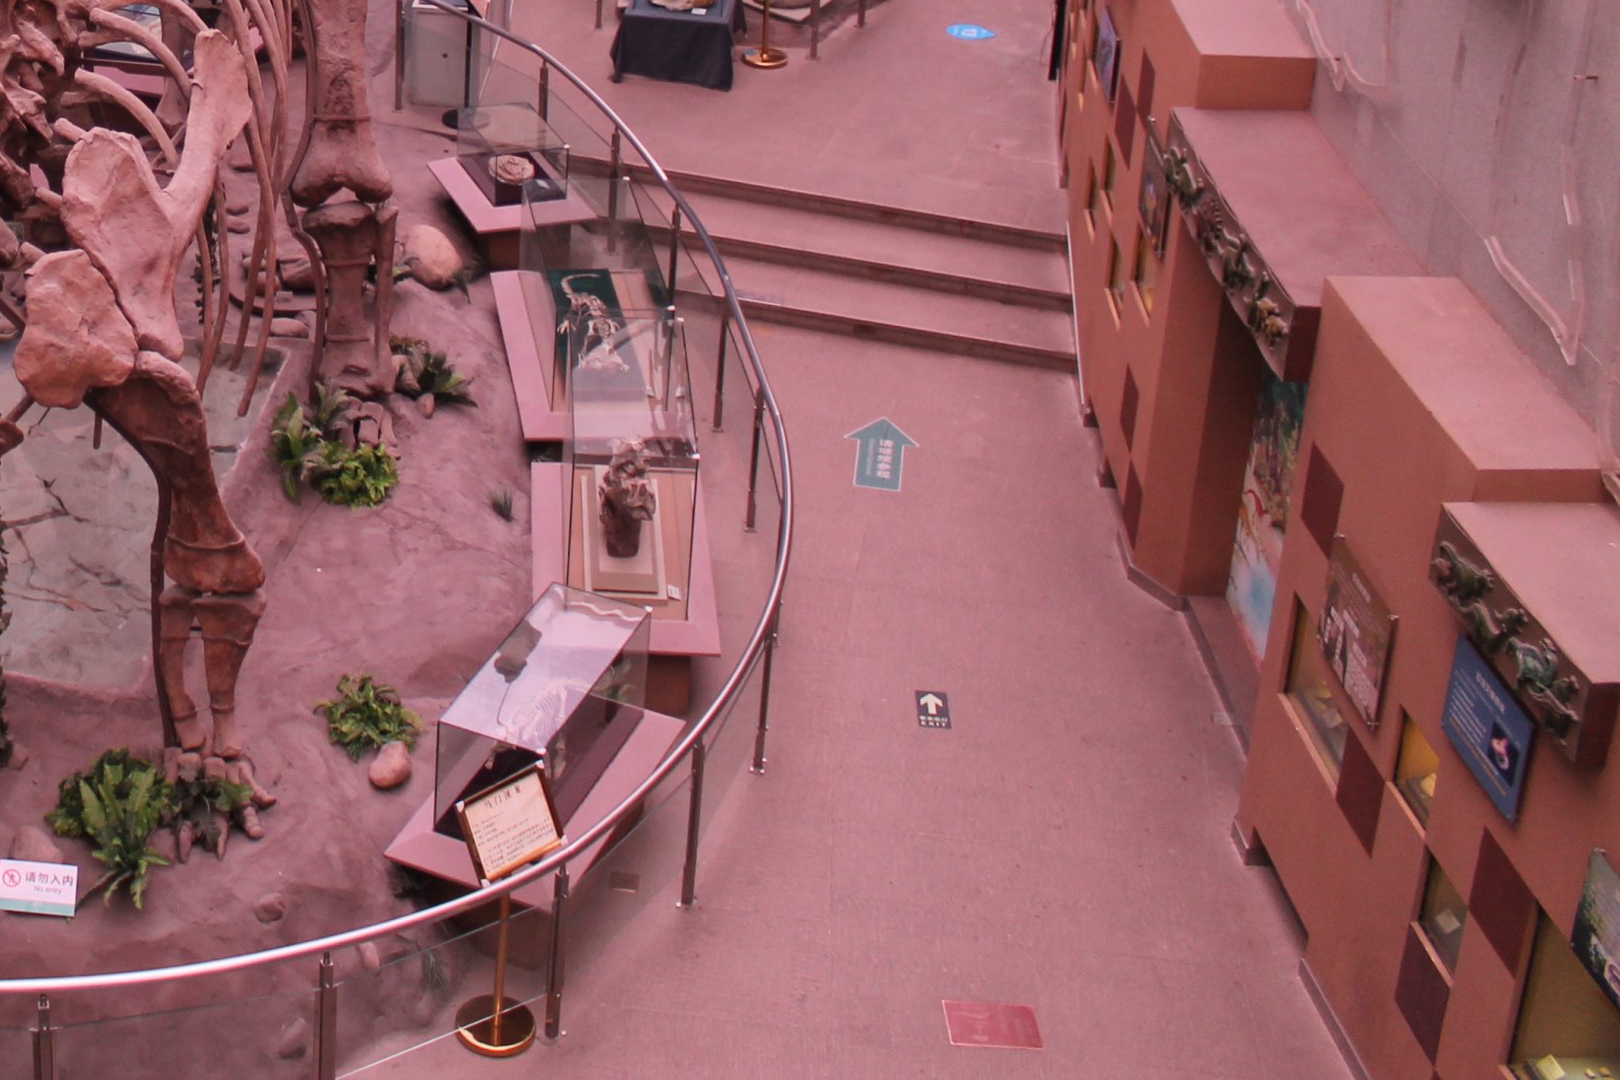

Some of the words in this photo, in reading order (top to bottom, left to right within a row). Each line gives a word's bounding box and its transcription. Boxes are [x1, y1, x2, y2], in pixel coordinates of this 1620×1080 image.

[25, 871, 74, 887] 请勿入内
[33, 885, 44, 893] No
[45, 887, 62, 896] entry
